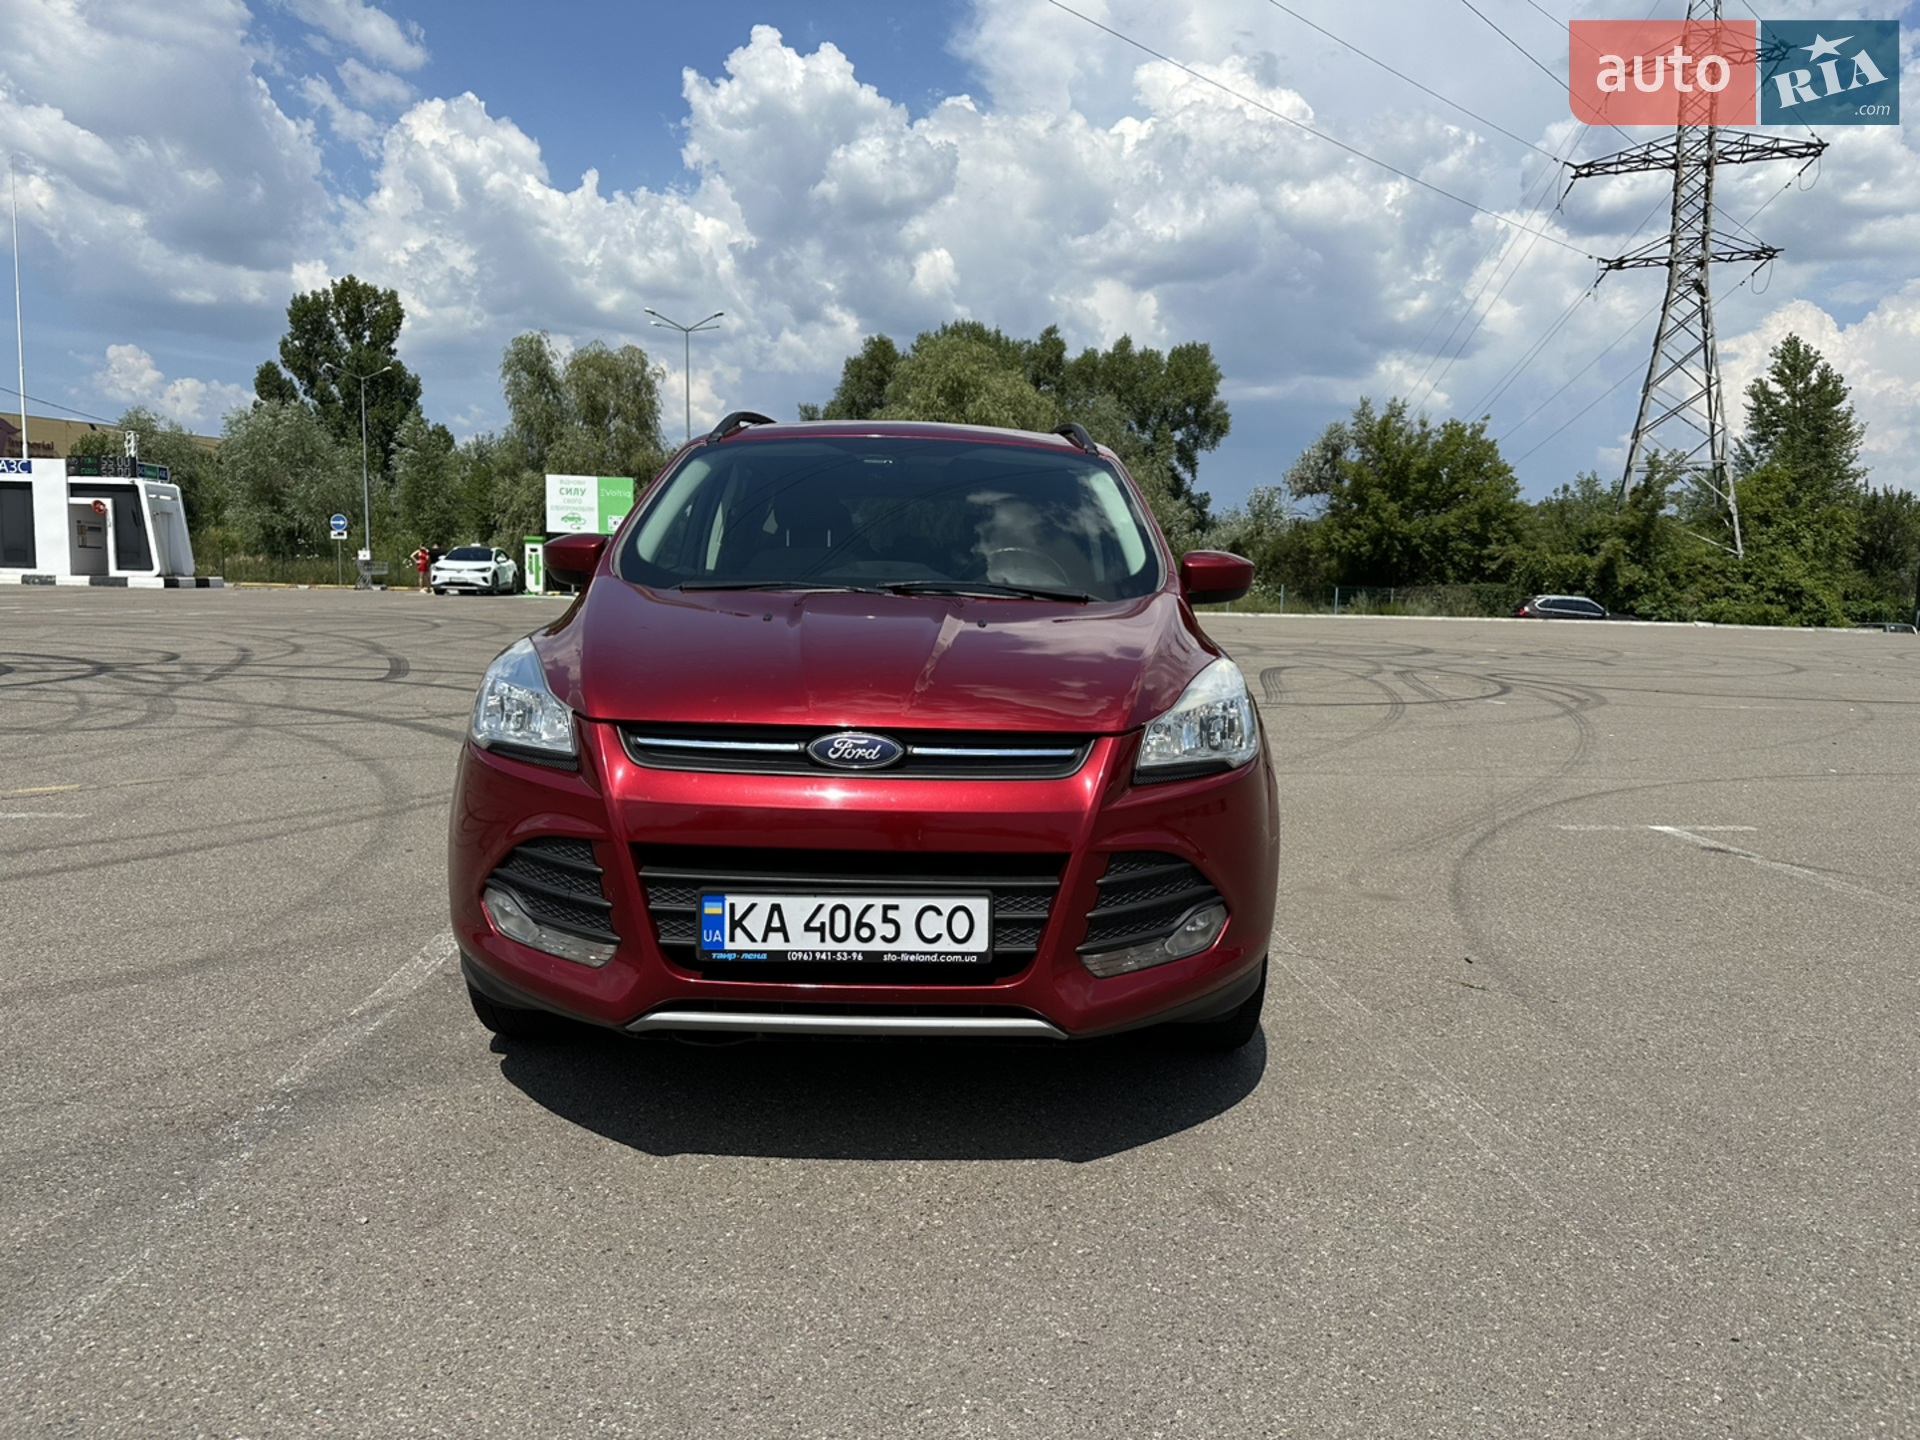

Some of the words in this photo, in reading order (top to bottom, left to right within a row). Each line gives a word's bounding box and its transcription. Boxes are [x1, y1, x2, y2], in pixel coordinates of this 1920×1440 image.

[8, 437, 54, 451] Imerial
[559, 487, 587, 496] СИЛУ
[827, 738, 882, 760] Ford
[728, 902, 791, 943] KA
[803, 903, 901, 944] 4065
[914, 904, 975, 945] CO
[703, 929, 722, 942] UA
[787, 951, 813, 961] (096)
[815, 951, 864, 961] 941-53-96
[882, 952, 978, 963] sto-tireland.com.ua
